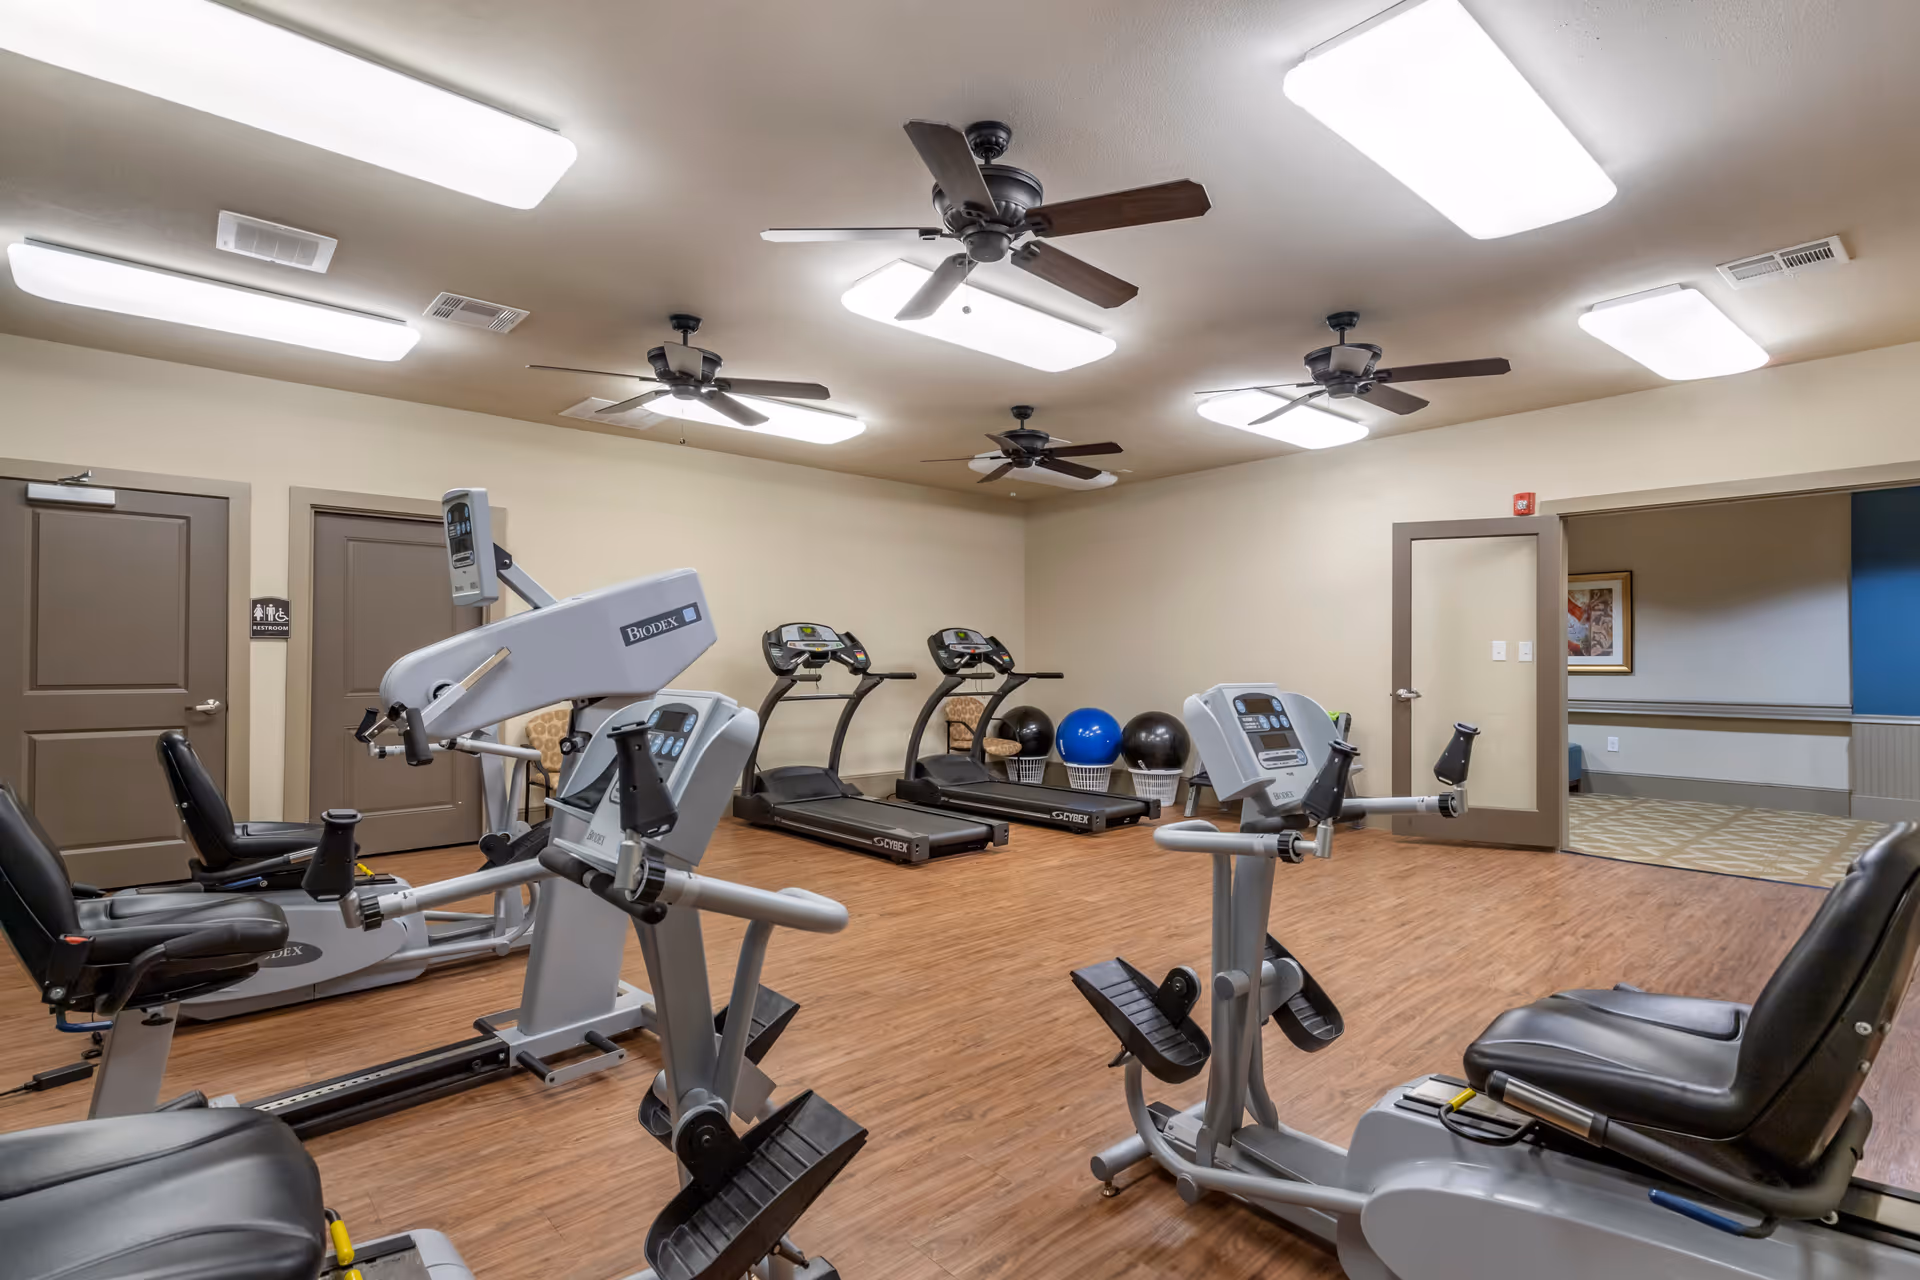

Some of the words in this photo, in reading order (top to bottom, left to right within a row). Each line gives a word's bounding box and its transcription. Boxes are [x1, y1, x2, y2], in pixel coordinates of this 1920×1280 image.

[626, 616, 680, 642] BIODEX
[1063, 812, 1089, 824] CYBEX
[884, 838, 908, 853] CYBEX
[264, 945, 303, 960] DEX
